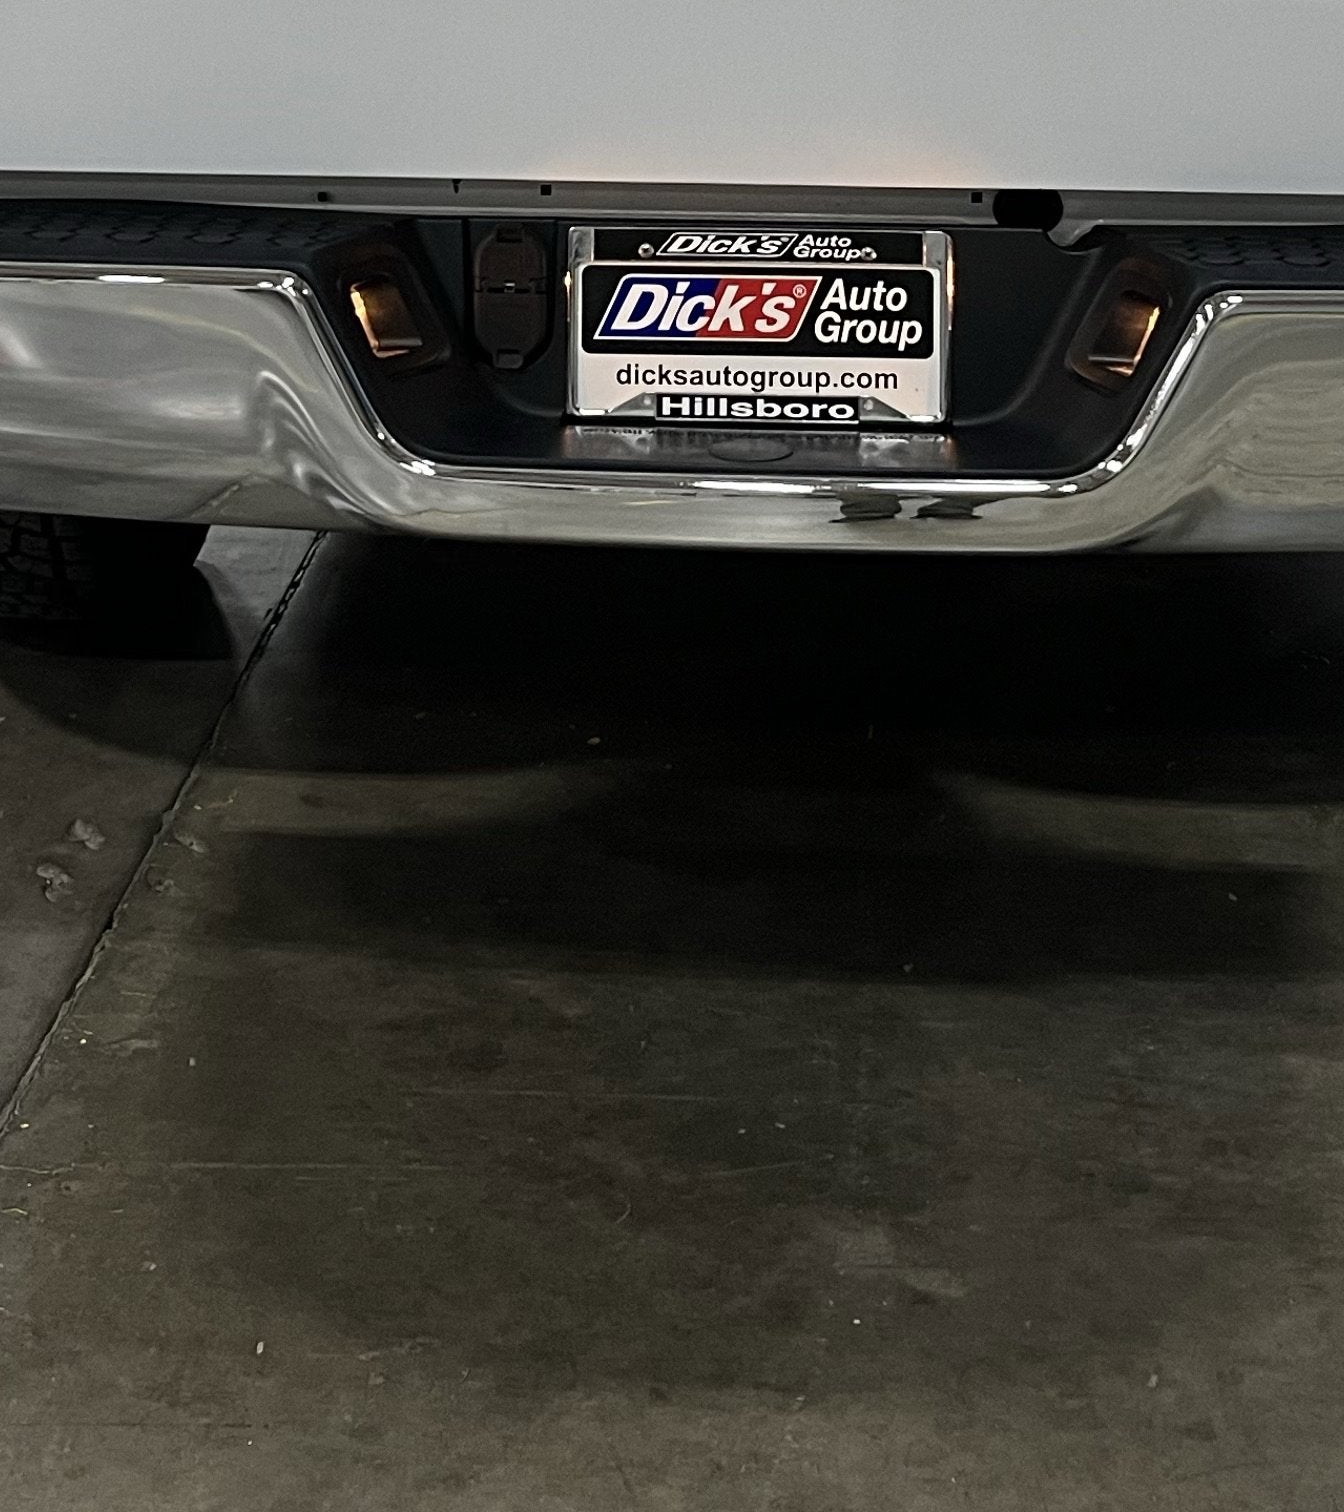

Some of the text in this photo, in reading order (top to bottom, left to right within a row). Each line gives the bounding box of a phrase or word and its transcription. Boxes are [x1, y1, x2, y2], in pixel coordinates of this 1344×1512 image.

[666, 233, 783, 254] Dick's
[793, 245, 861, 262] Group
[798, 234, 852, 248] Auto
[609, 280, 796, 334] Dick's
[820, 277, 908, 313] Auto
[813, 311, 924, 352] Group
[615, 362, 899, 394] dicksautogroup.com
[661, 396, 855, 420] Hillsboro
